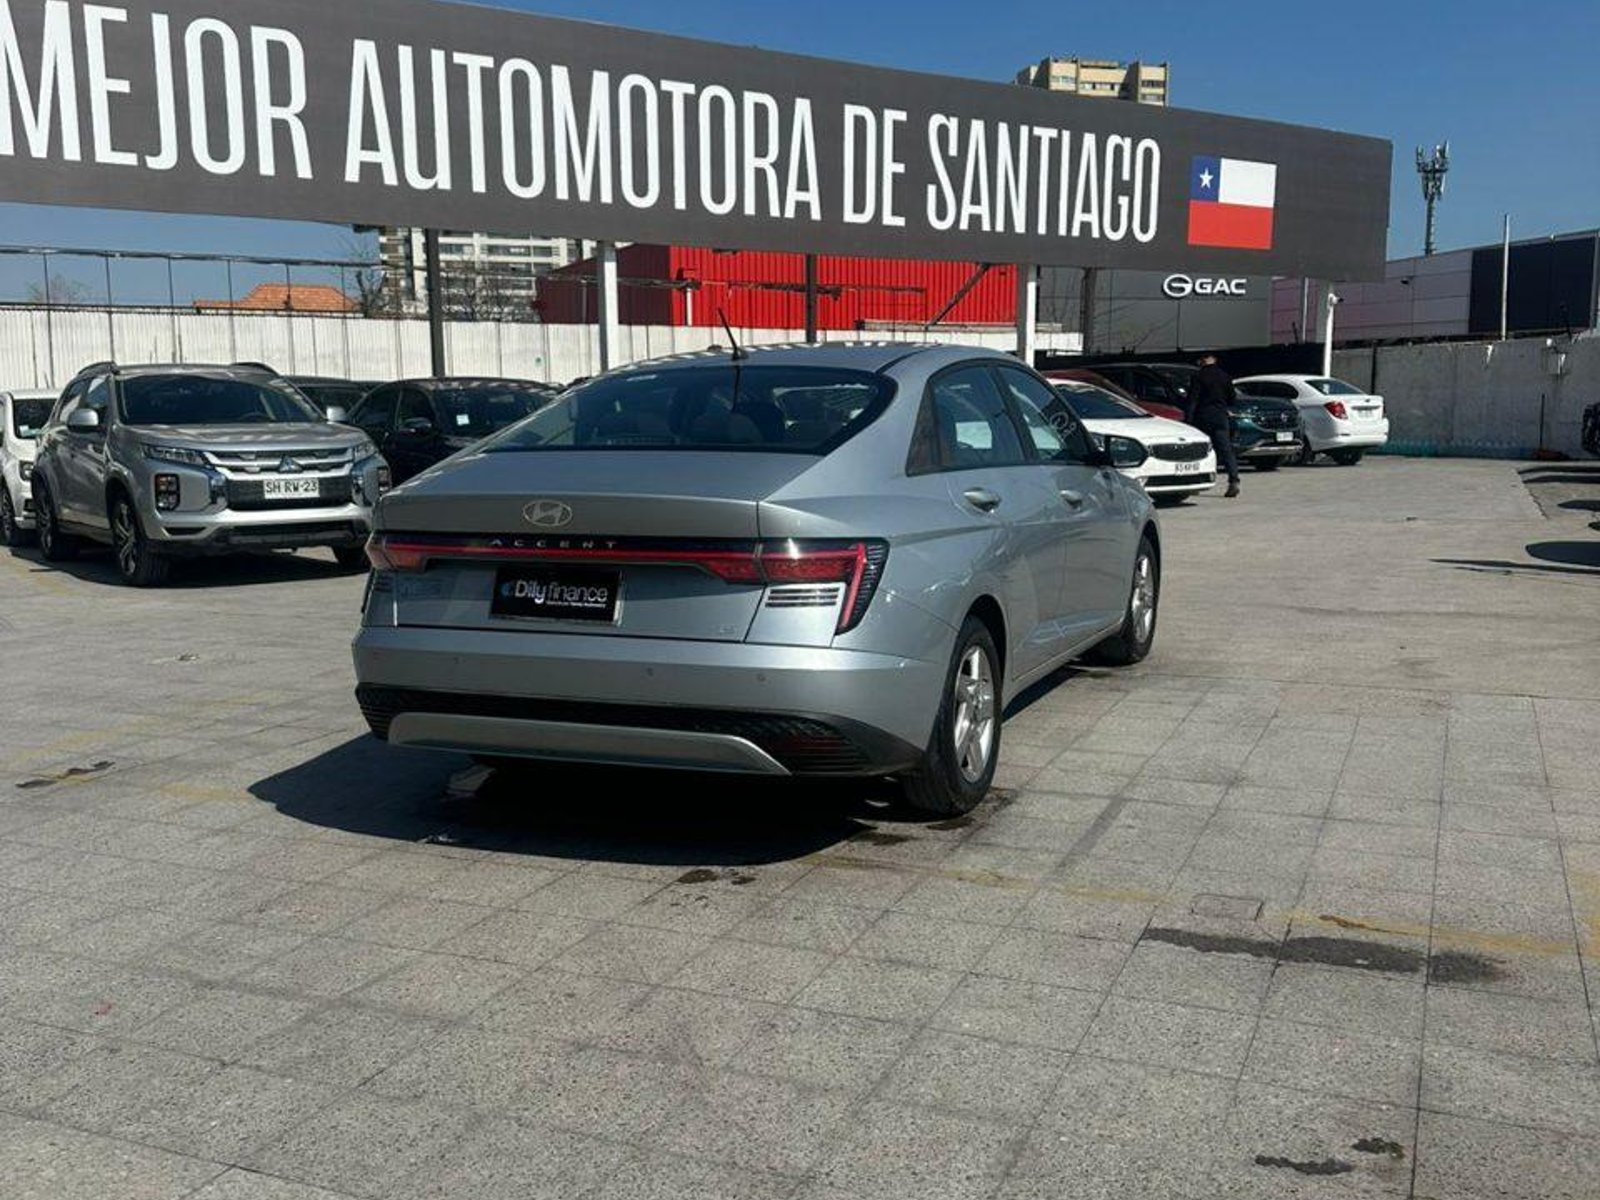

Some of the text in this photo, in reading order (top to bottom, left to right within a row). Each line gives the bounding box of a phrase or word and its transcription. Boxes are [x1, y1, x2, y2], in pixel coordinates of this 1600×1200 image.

[0, 0, 1161, 243] MEJOR AUTOMOTORA DE SANTIAGO
[489, 538, 618, 549] ACCENT
